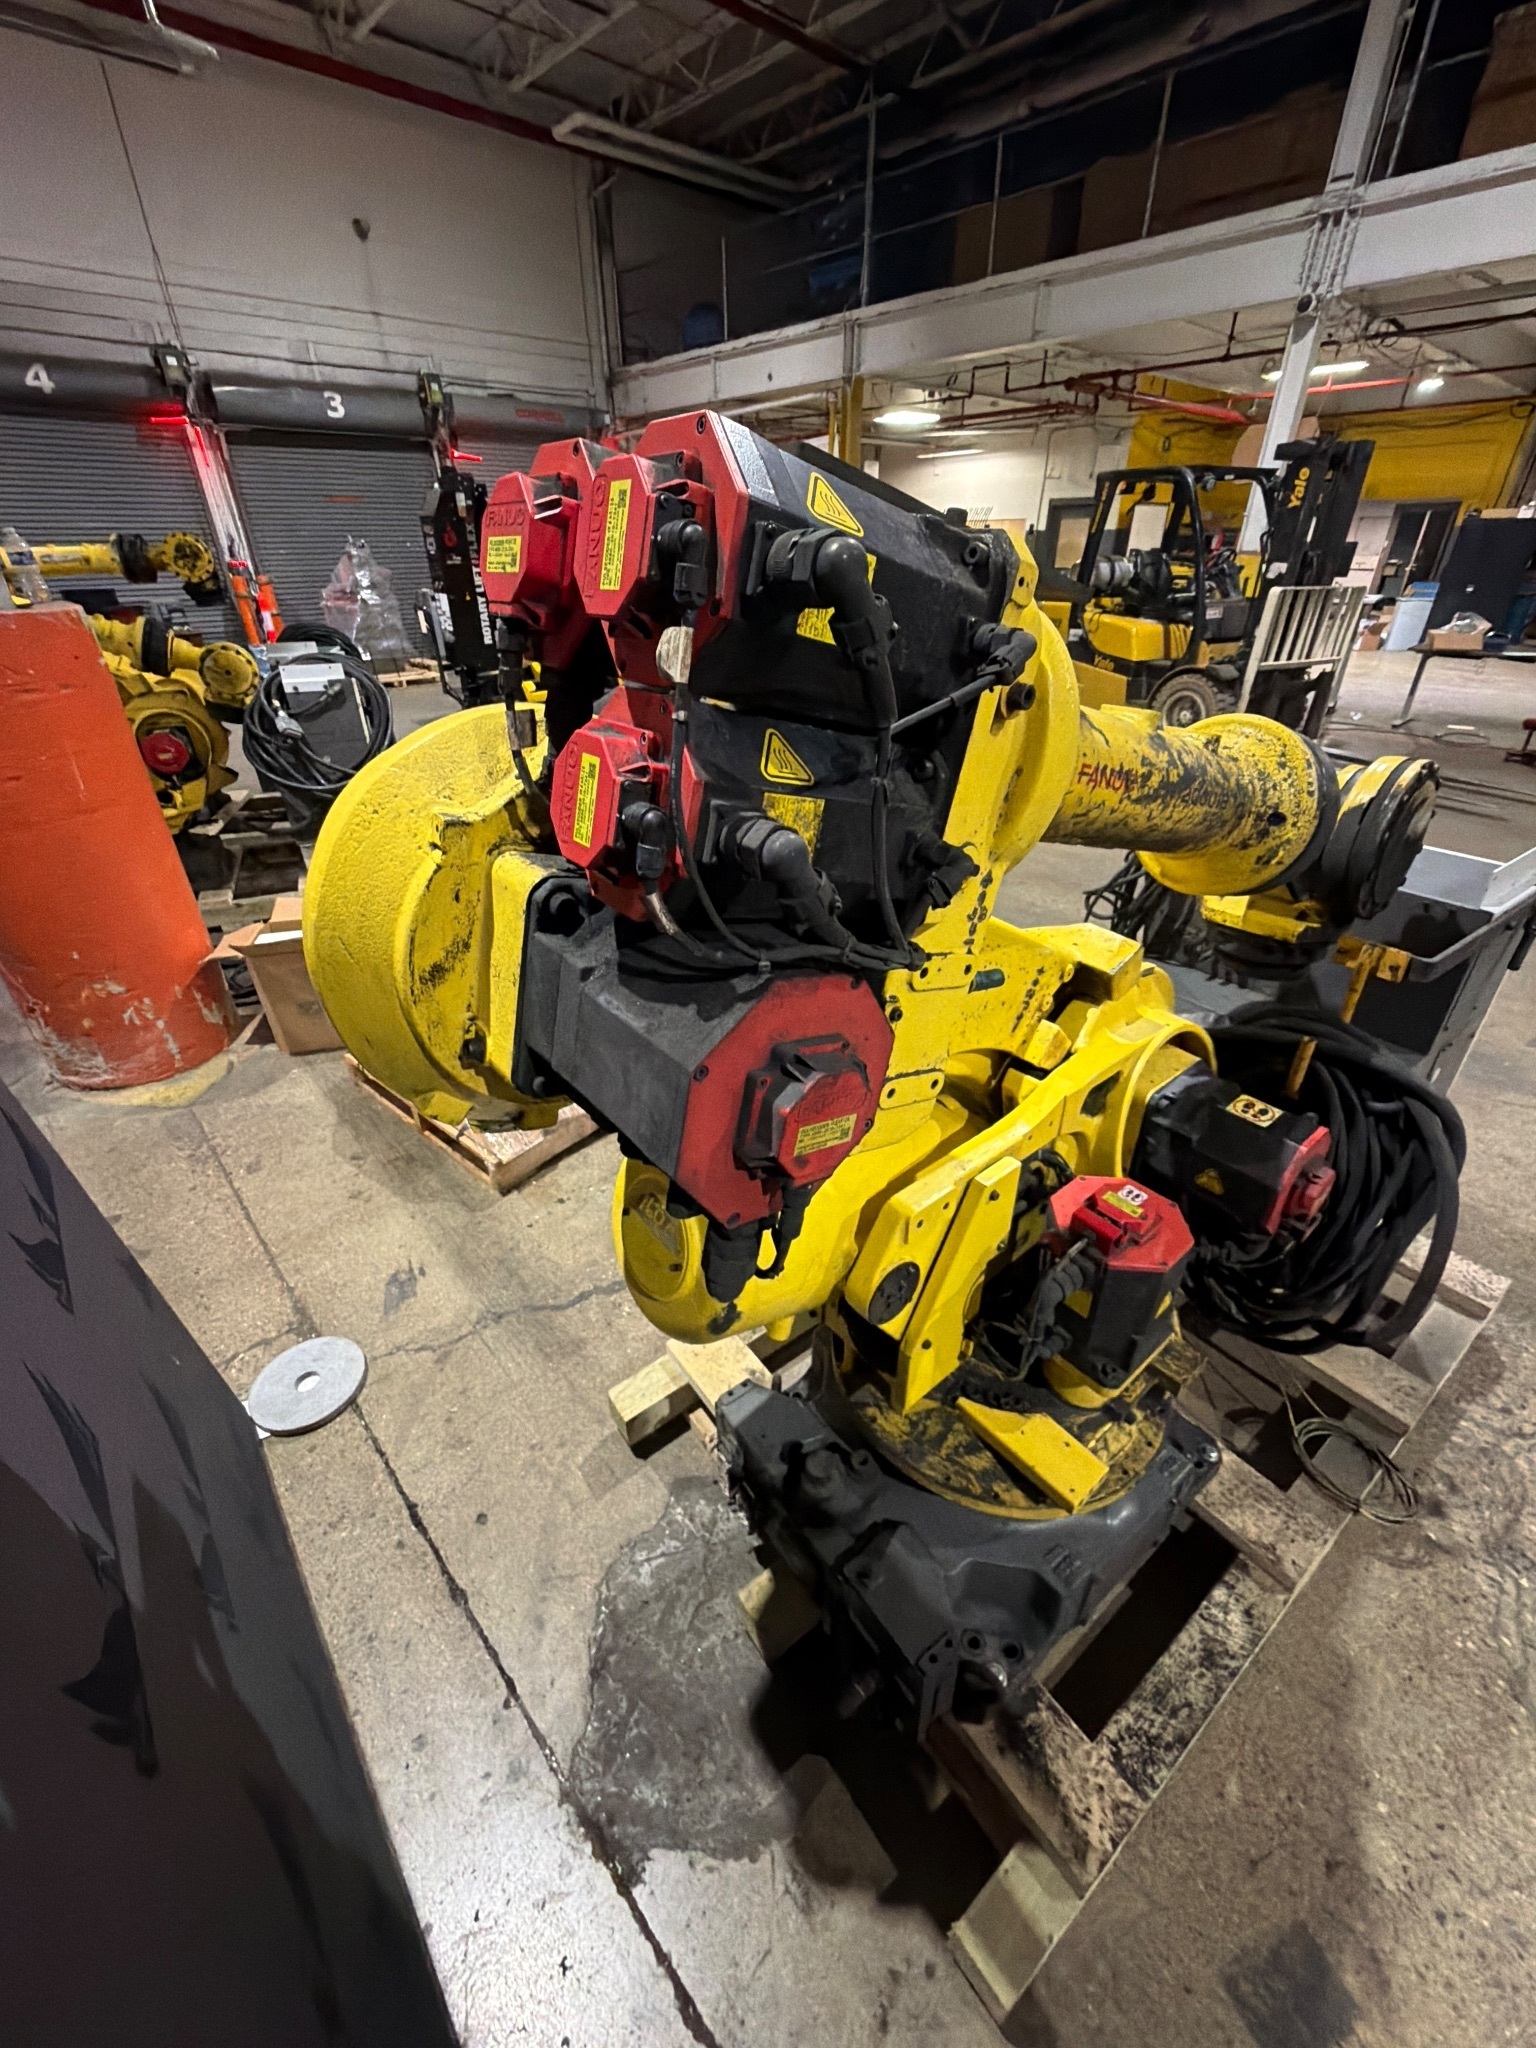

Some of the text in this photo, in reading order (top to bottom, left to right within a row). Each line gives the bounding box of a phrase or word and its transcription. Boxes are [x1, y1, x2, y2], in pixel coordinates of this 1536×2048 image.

[25, 363, 55, 394] 4
[323, 391, 345, 418] 3
[1287, 467, 1310, 508] Yale
[471, 565, 485, 593] LIFT
[477, 595, 493, 645] ROTARY
